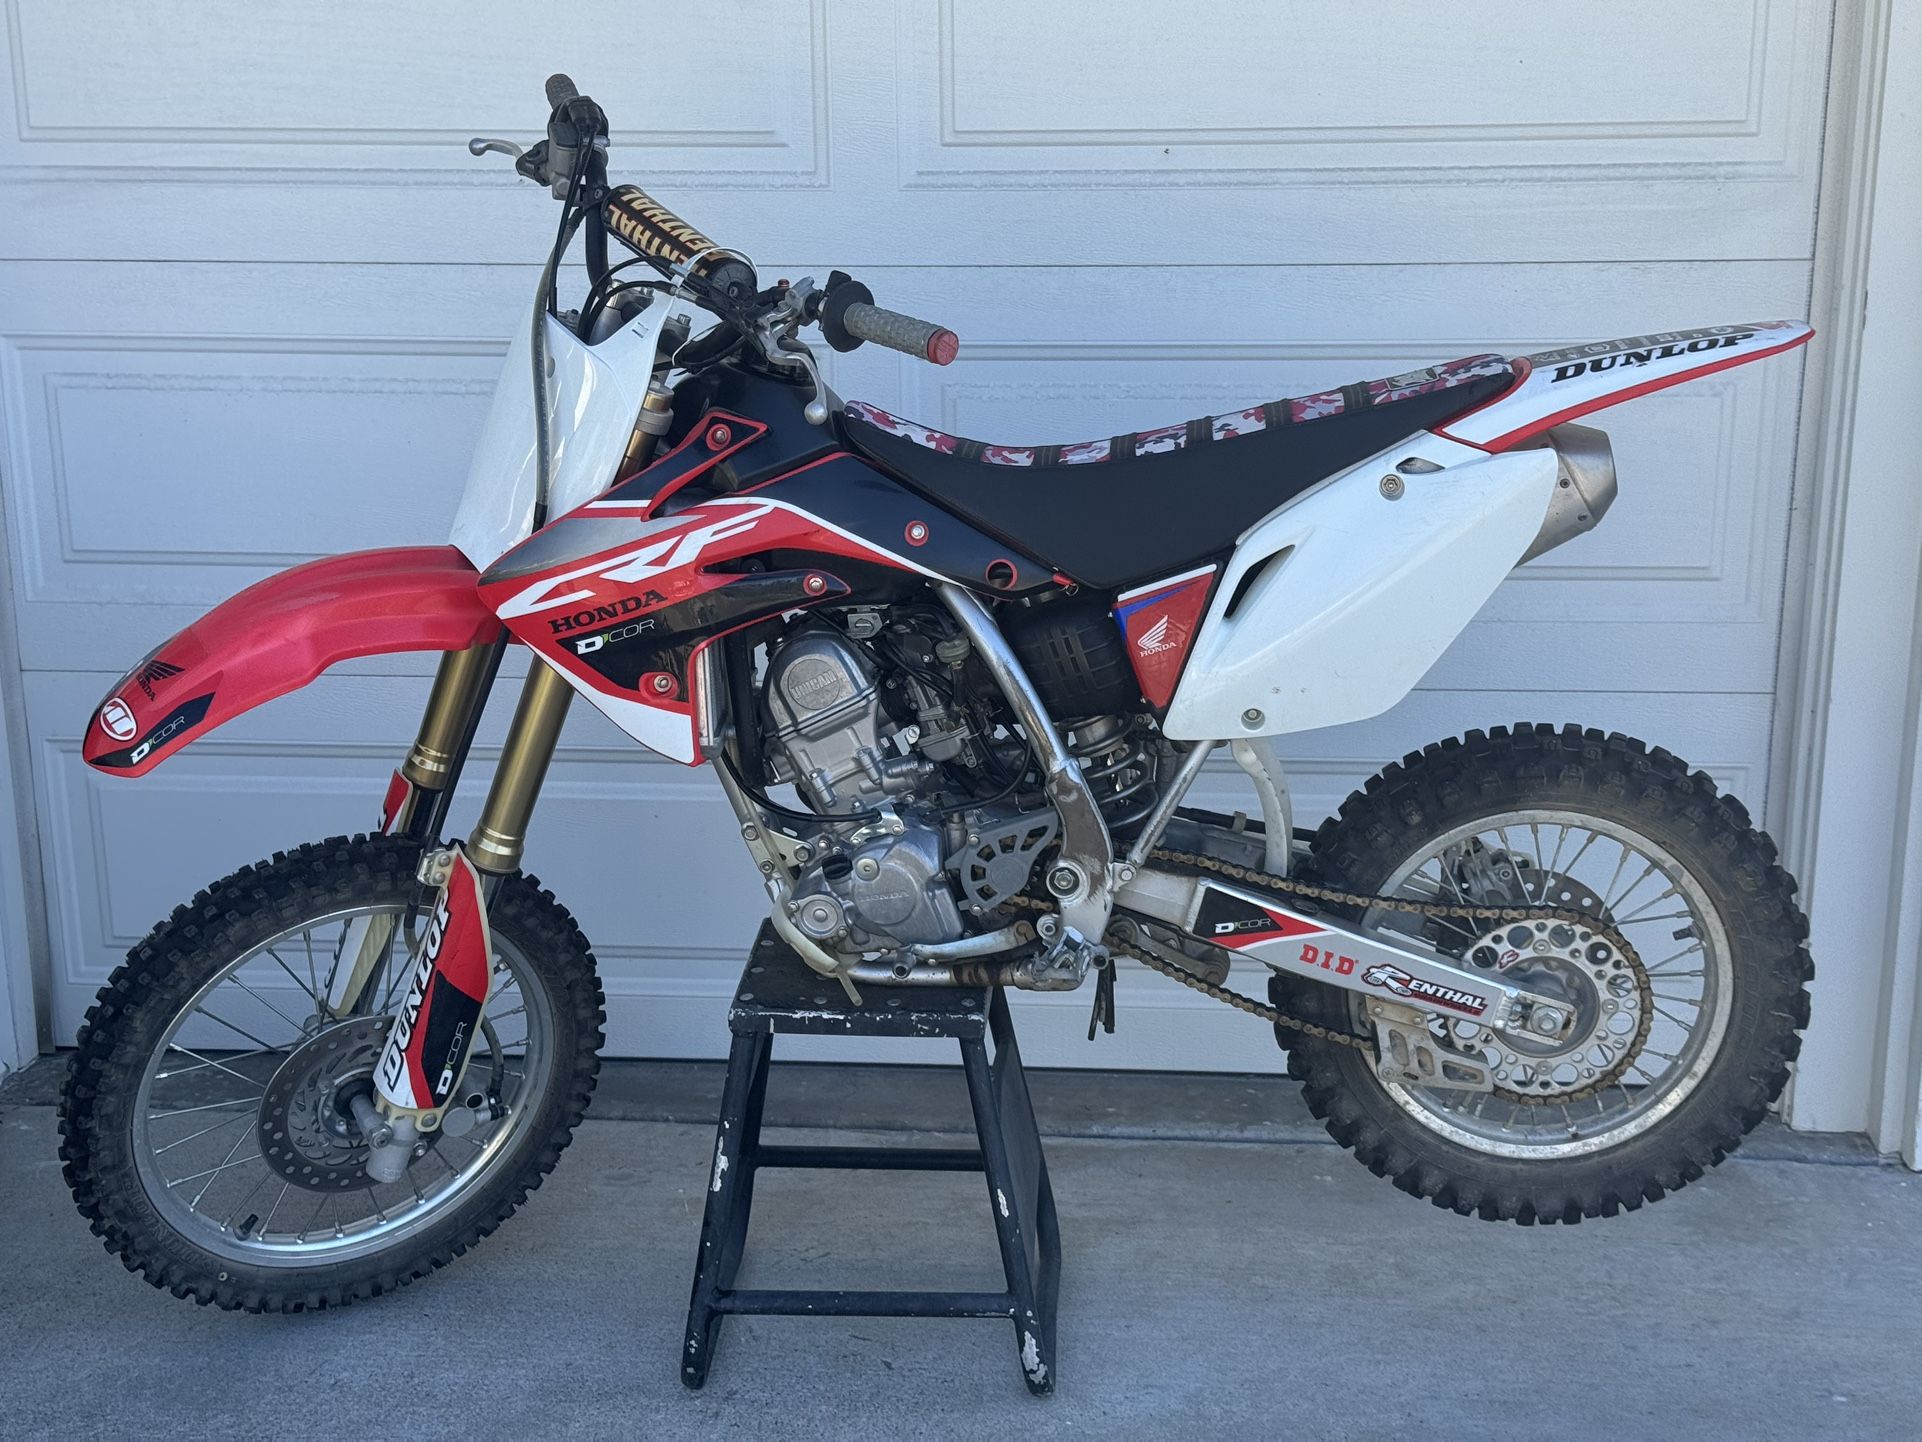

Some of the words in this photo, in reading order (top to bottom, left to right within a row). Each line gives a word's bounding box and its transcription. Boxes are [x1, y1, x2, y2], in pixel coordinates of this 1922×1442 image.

[1551, 333, 1755, 383] DUNLOP
[496, 503, 776, 620] CRF
[548, 589, 668, 634] HONDA
[1140, 641, 1177, 658] HONDA
[790, 669, 837, 699] UNICAM
[383, 888, 451, 1093] DUNLOP
